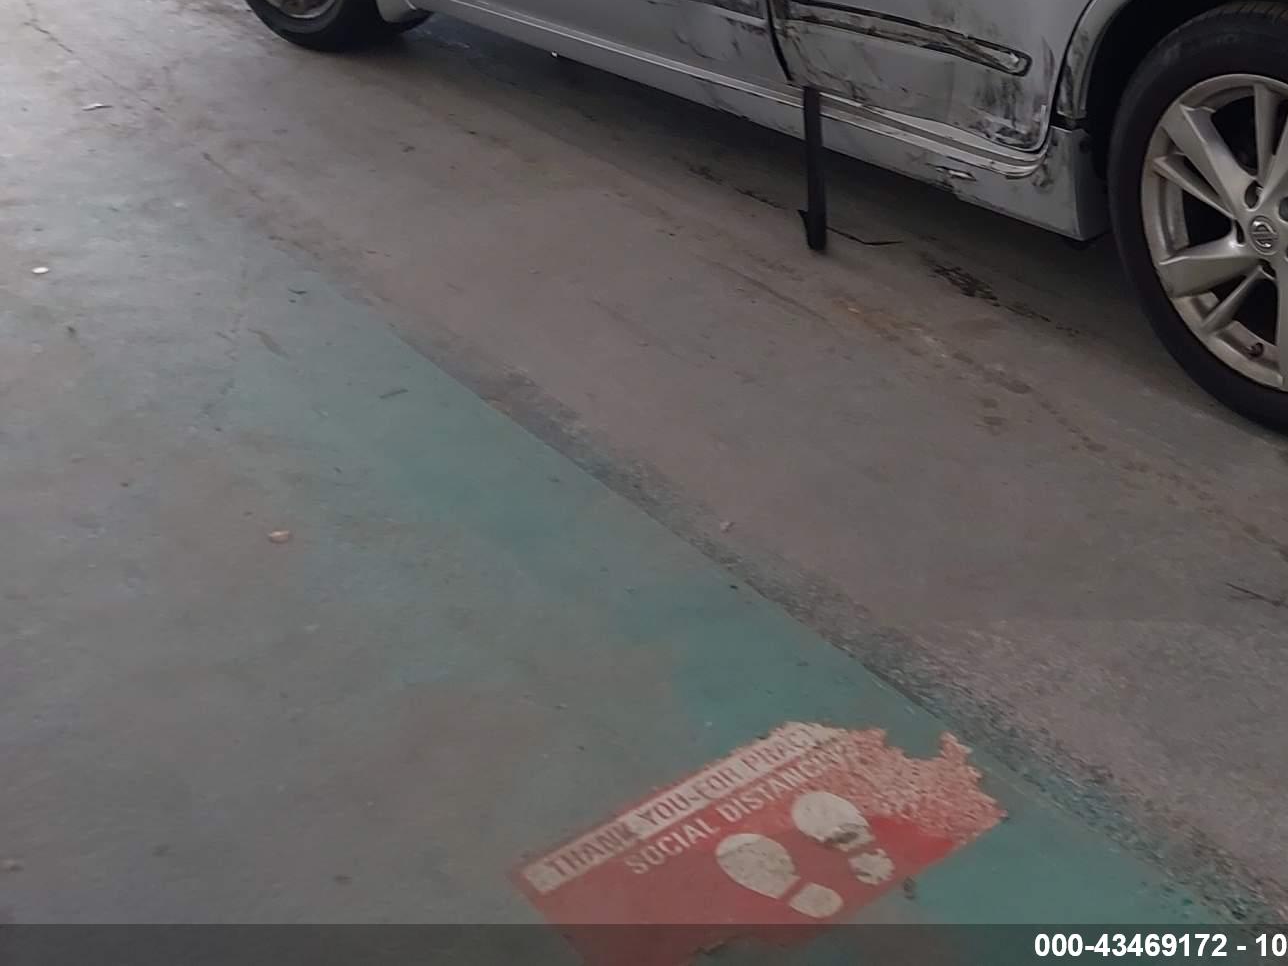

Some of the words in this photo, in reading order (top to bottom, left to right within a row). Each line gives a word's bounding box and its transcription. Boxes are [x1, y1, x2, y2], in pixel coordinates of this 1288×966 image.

[547, 821, 634, 876] THANK
[635, 792, 692, 826] YOU
[694, 766, 742, 802] FOR
[625, 818, 721, 874] SOCIAL
